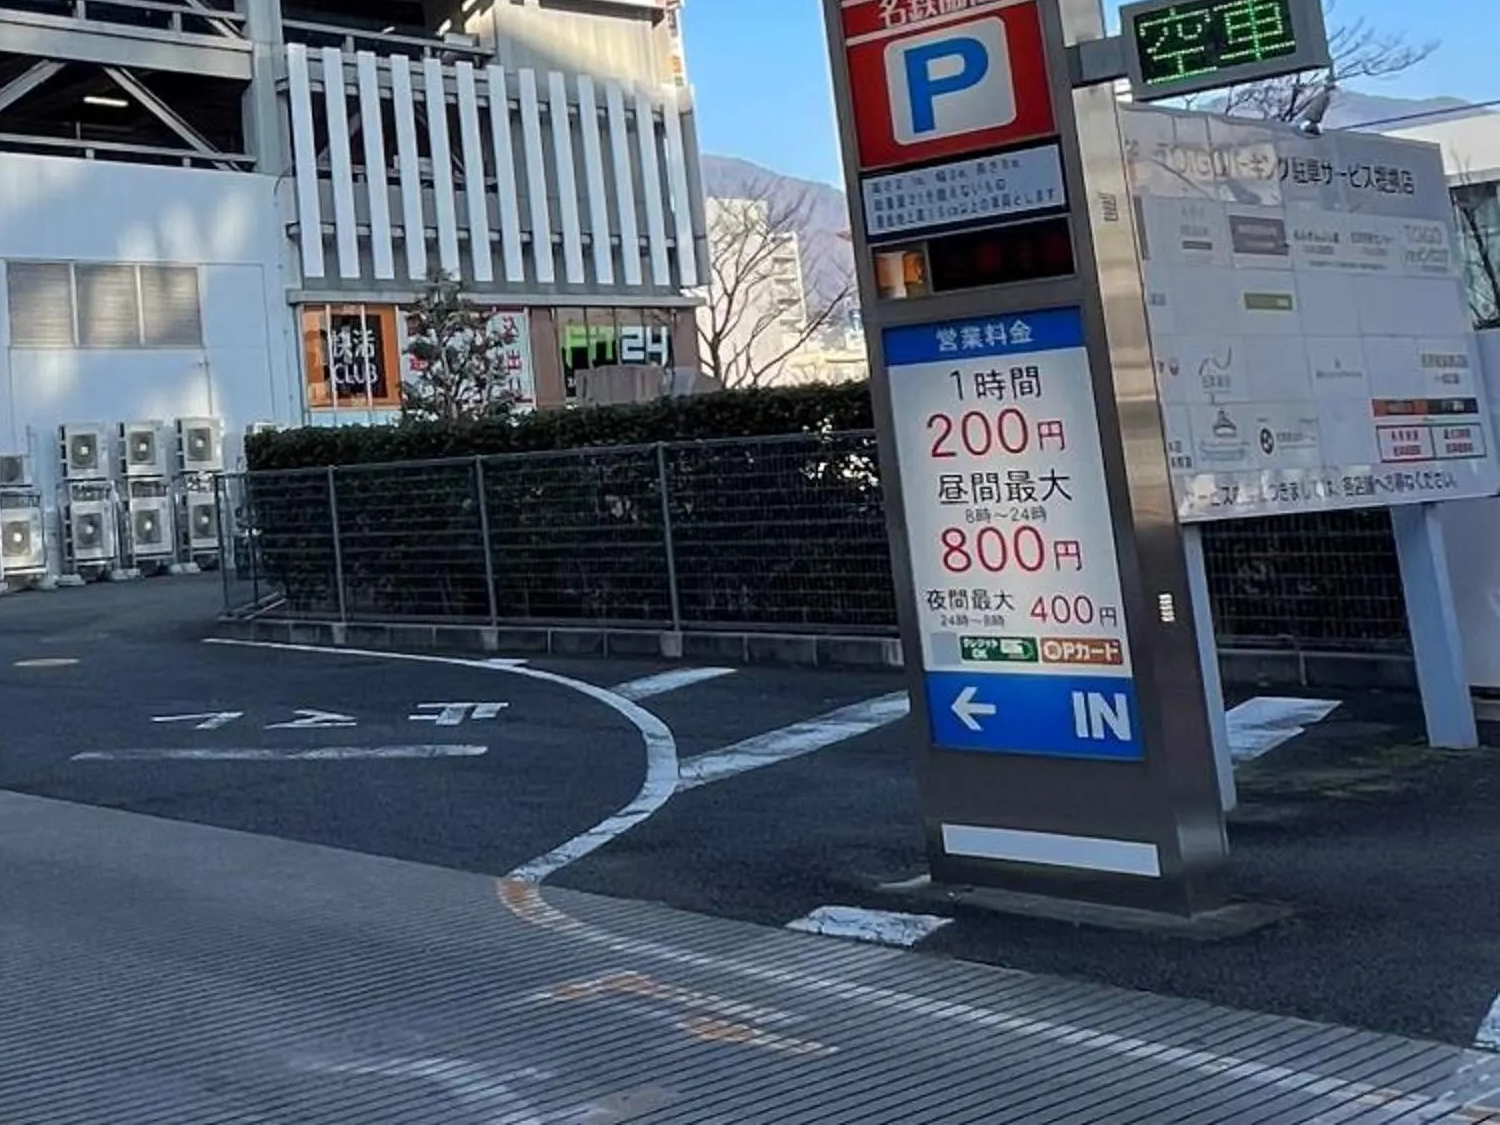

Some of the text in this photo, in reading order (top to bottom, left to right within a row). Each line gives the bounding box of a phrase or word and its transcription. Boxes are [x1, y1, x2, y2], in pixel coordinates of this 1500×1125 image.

[904, 36, 990, 133] P
[935, 319, 1035, 352] 営業料金
[333, 363, 378, 385] CLUB
[949, 365, 1042, 401] 1時間
[926, 408, 1066, 458] 200円
[938, 468, 1073, 505] 昼間最大
[941, 526, 1082, 573] 800円
[926, 587, 1118, 627] 夜間最大 400円
[1071, 691, 1133, 743] IN
